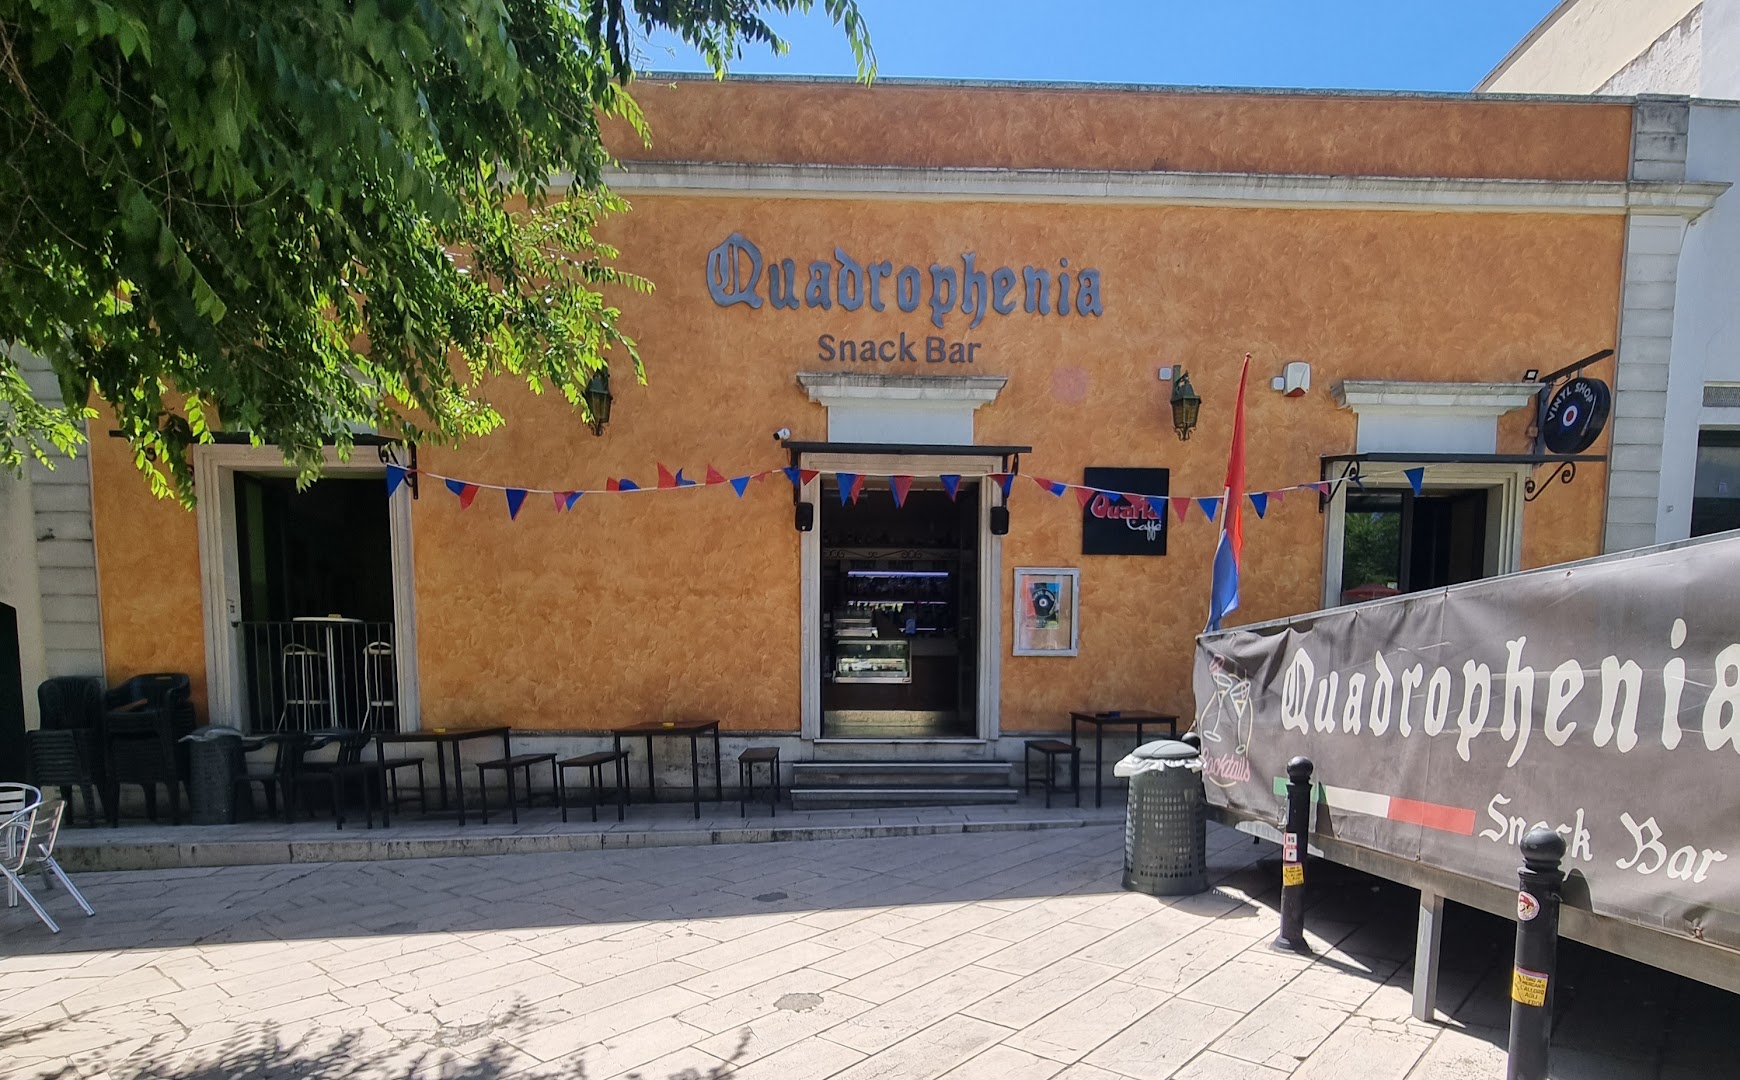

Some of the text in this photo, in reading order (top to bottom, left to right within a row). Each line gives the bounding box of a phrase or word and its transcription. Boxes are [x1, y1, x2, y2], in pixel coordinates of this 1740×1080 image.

[706, 232, 1104, 329] Quadrophenia
[818, 332, 981, 364] Snack Bar
[1547, 382, 1594, 421] VINYL SHOP
[1280, 618, 1740, 768] Quadrophenia
[1616, 811, 1728, 883] Bar
